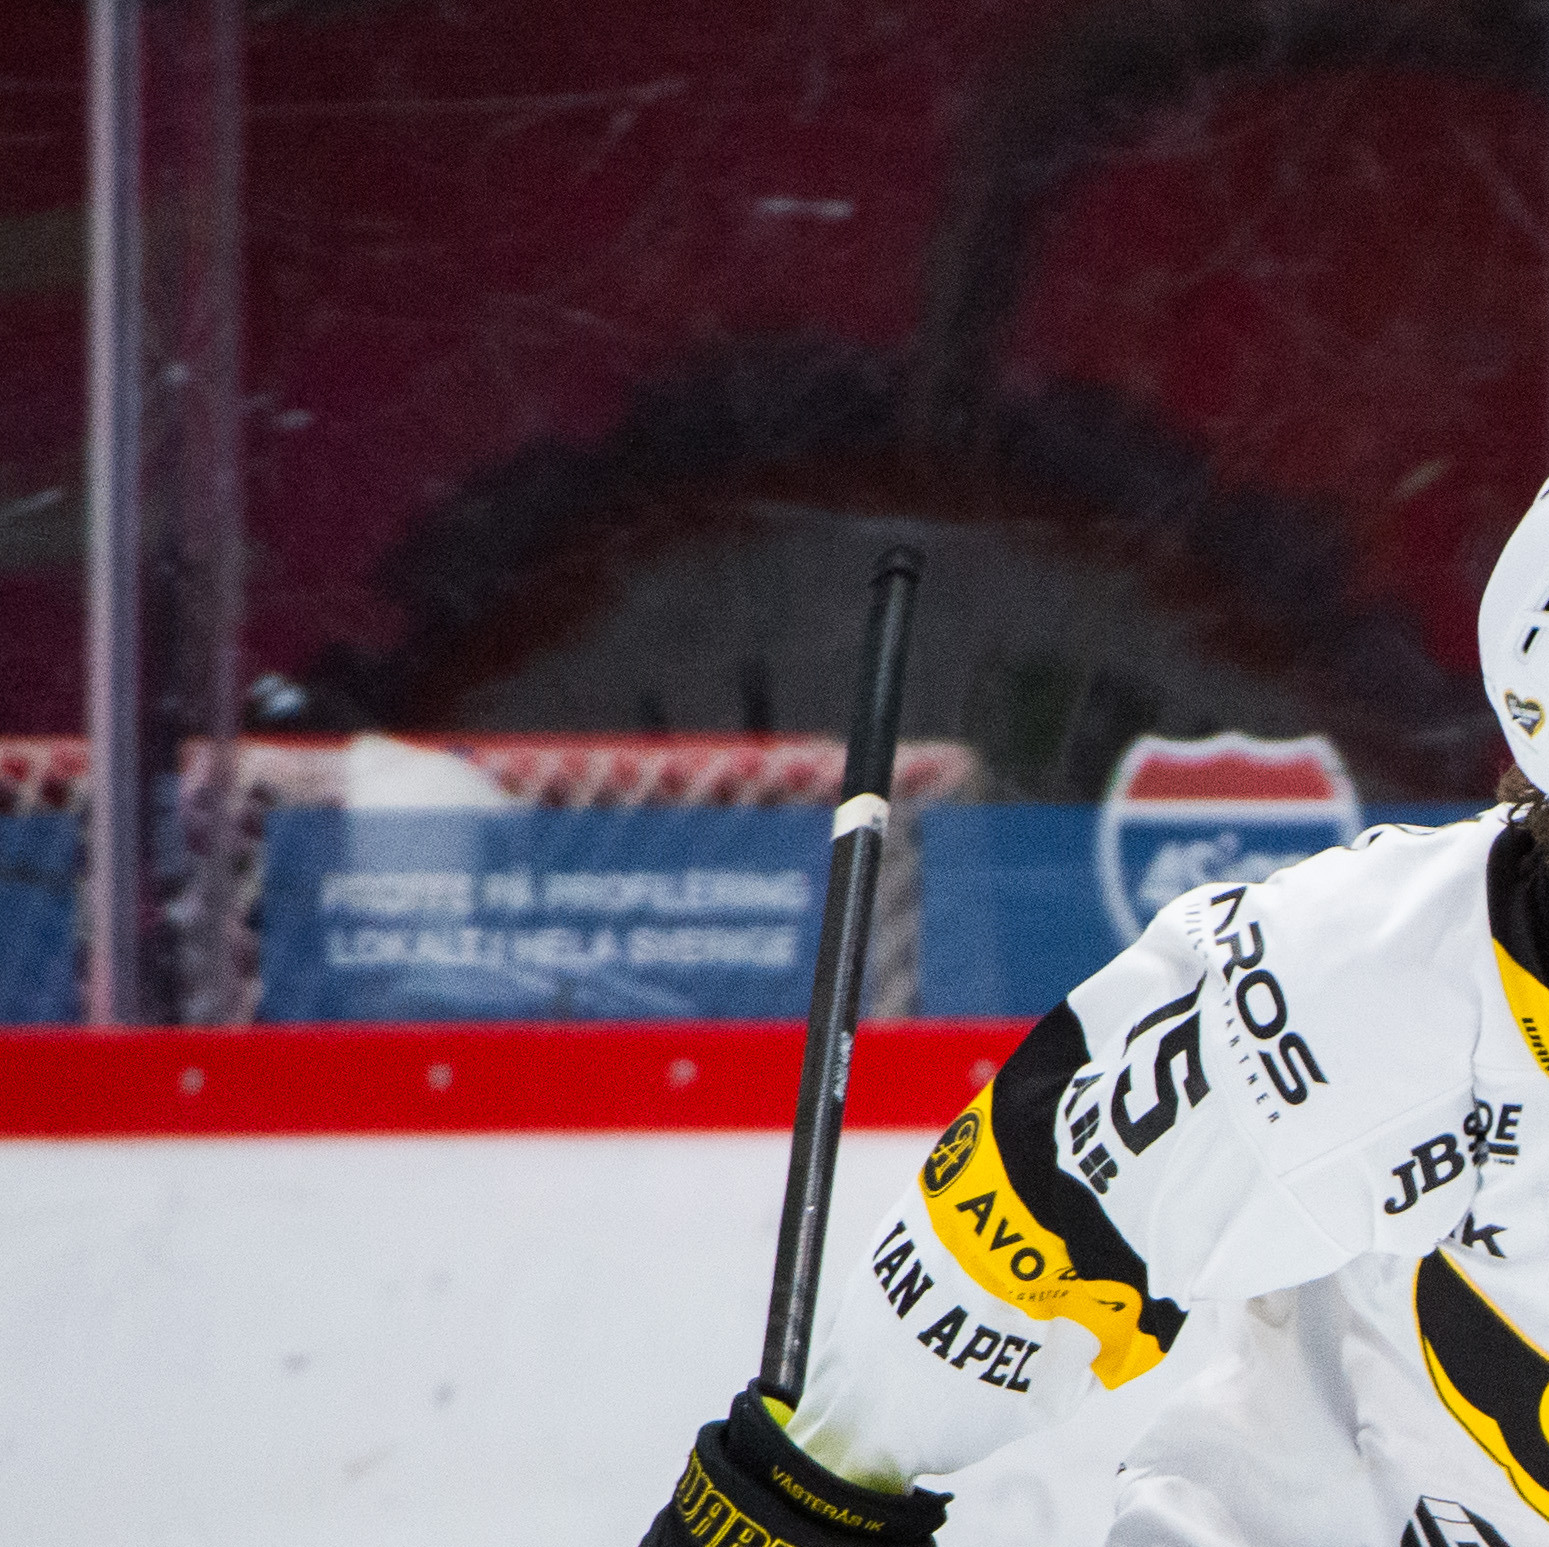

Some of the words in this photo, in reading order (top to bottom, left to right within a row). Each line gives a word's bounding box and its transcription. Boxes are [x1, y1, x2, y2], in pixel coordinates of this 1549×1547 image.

[1109, 969, 1212, 1157] 15
[1210, 885, 1330, 1107] AROS
[917, 1304, 1042, 1393] APEL
